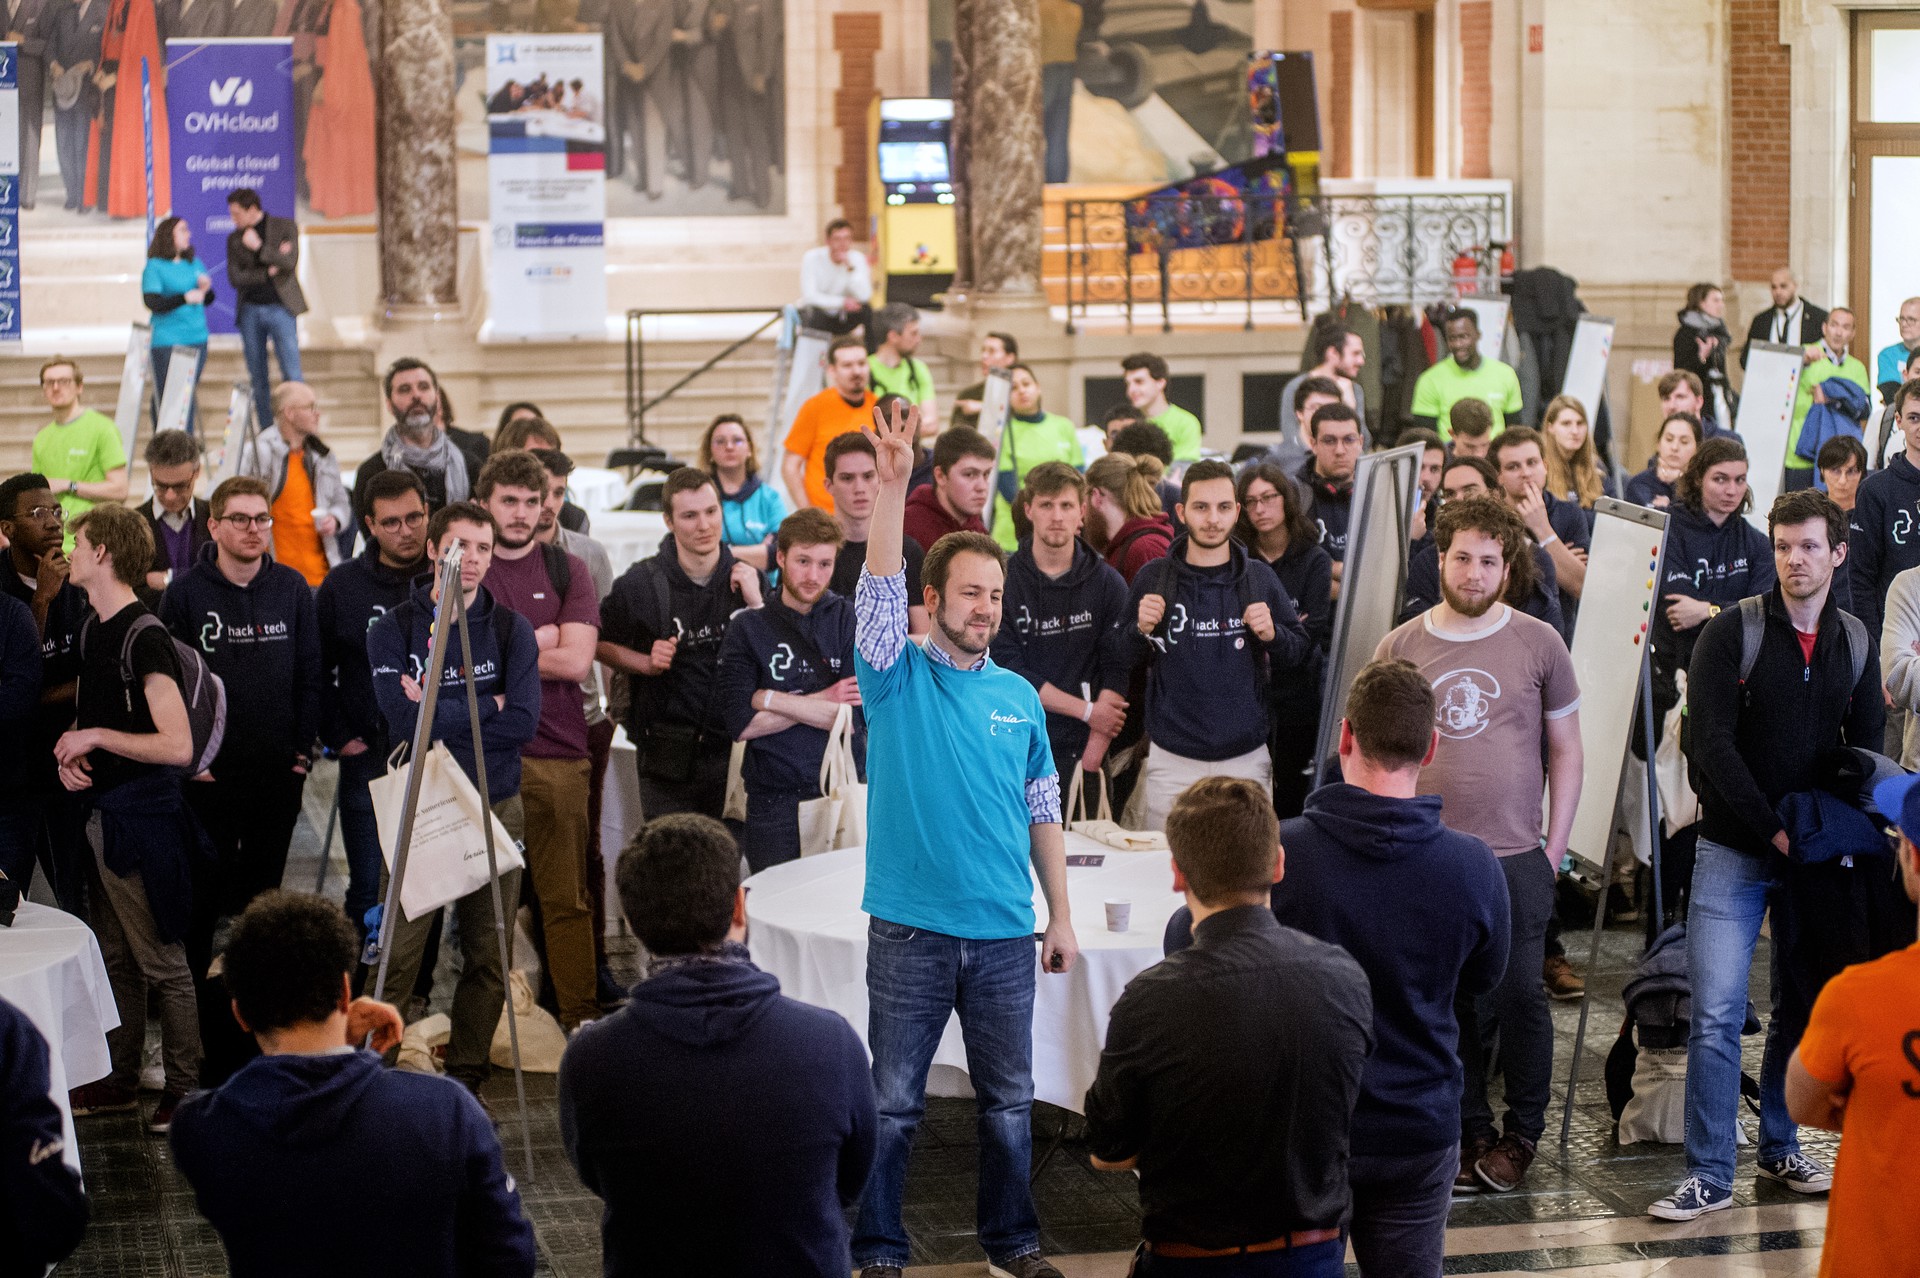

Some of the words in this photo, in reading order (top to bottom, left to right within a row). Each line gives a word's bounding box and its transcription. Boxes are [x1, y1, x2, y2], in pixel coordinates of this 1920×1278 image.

[184, 110, 279, 134] OVHcloud
[185, 153, 235, 173] Global
[236, 152, 280, 172] cloud
[201, 172, 265, 192] provider
[990, 708, 1028, 724] Inria
